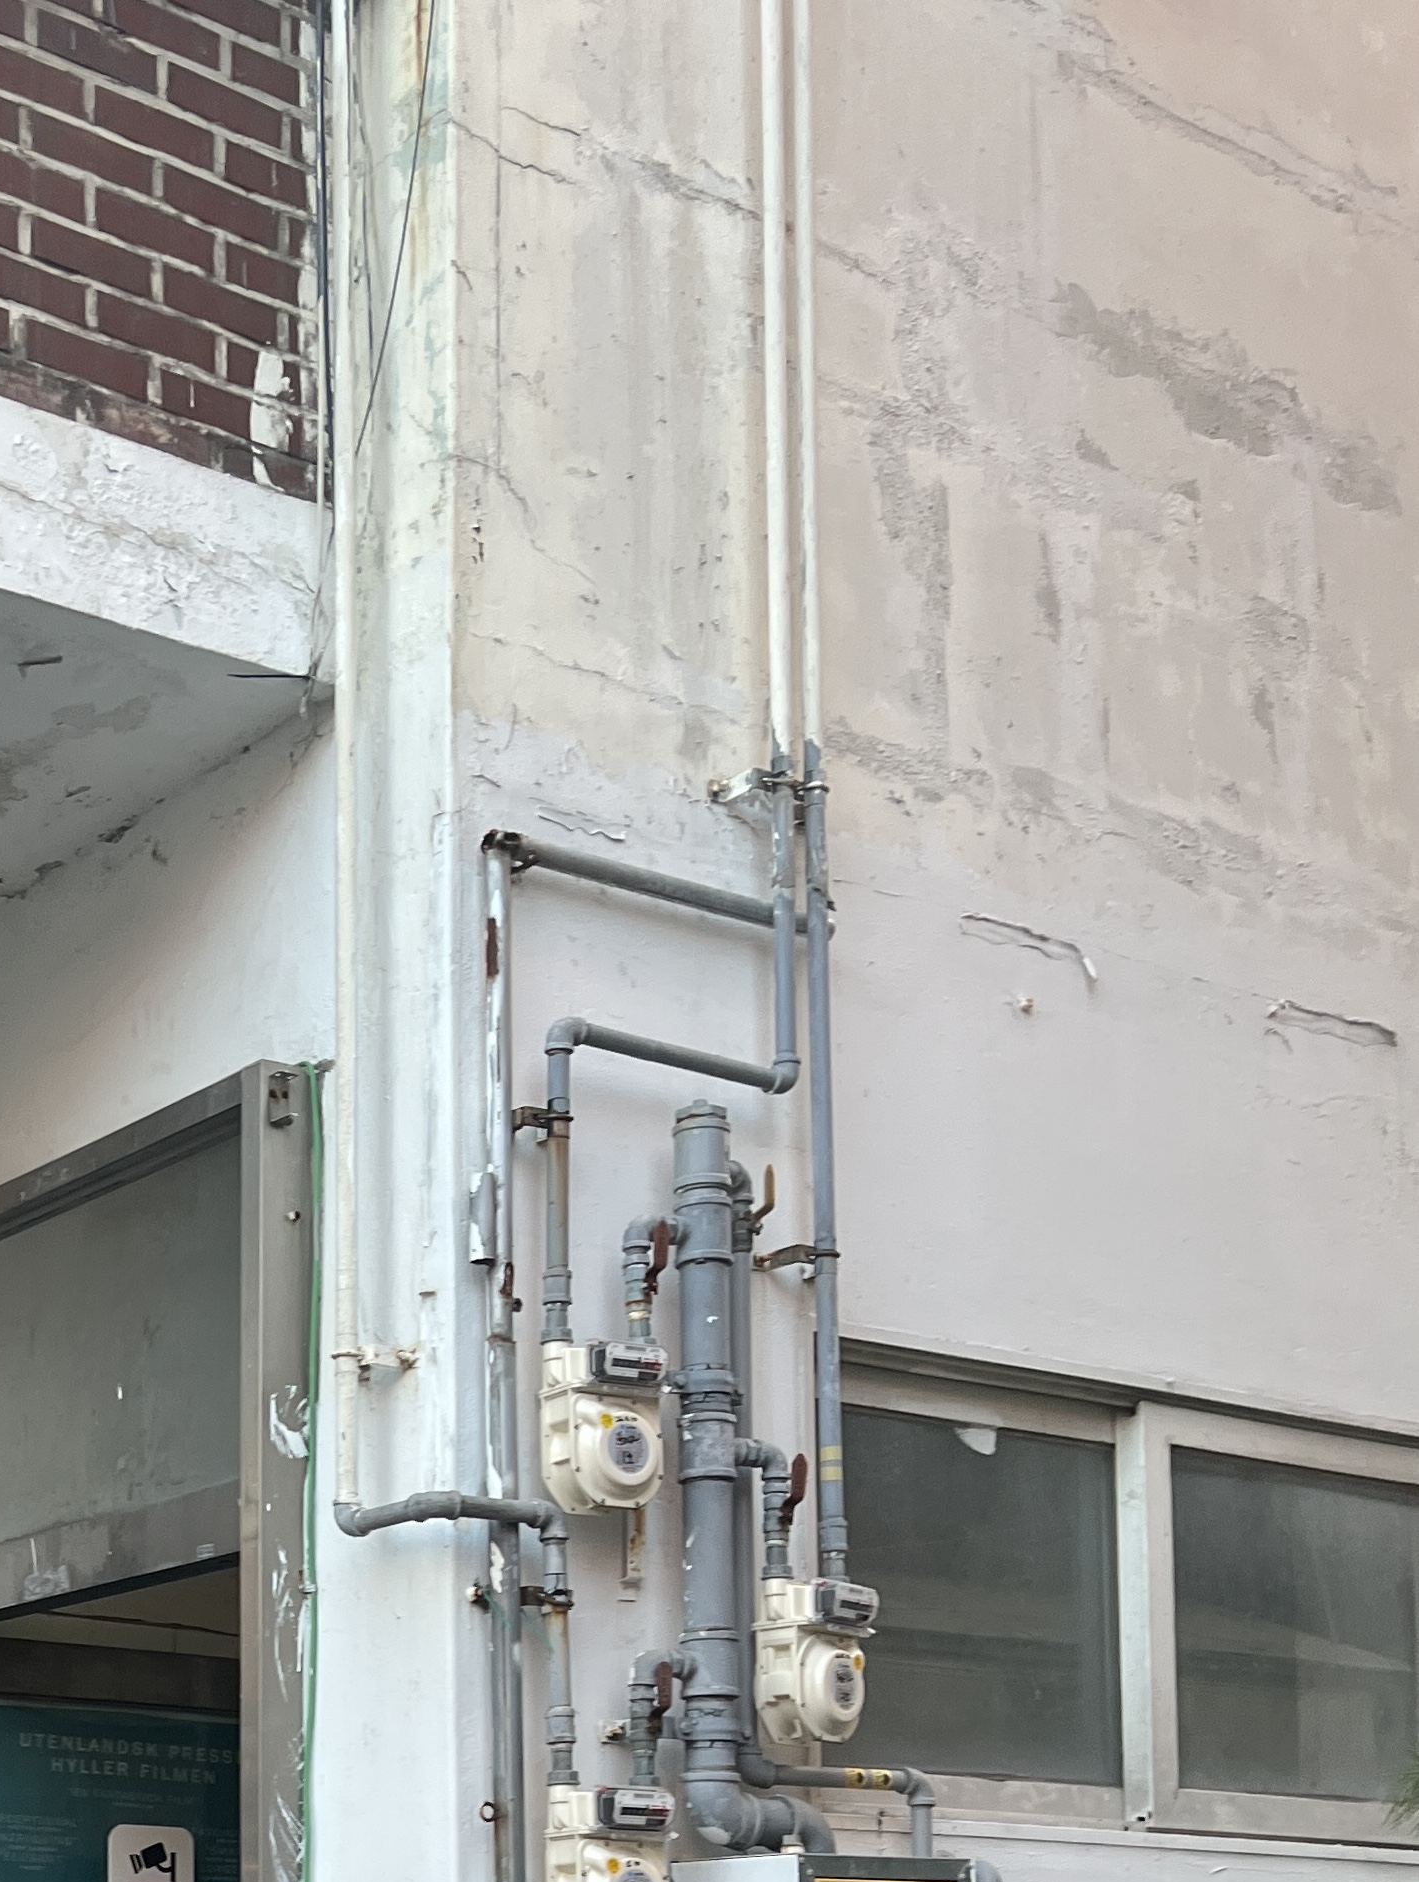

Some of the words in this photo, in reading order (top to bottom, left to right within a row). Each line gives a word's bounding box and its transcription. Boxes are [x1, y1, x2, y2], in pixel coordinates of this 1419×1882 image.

[19, 1732, 160, 1758] UTENLANDSK
[168, 1744, 240, 1765] PRESS
[51, 1757, 129, 1777] HYLLER
[139, 1763, 216, 1785] FILMEN
